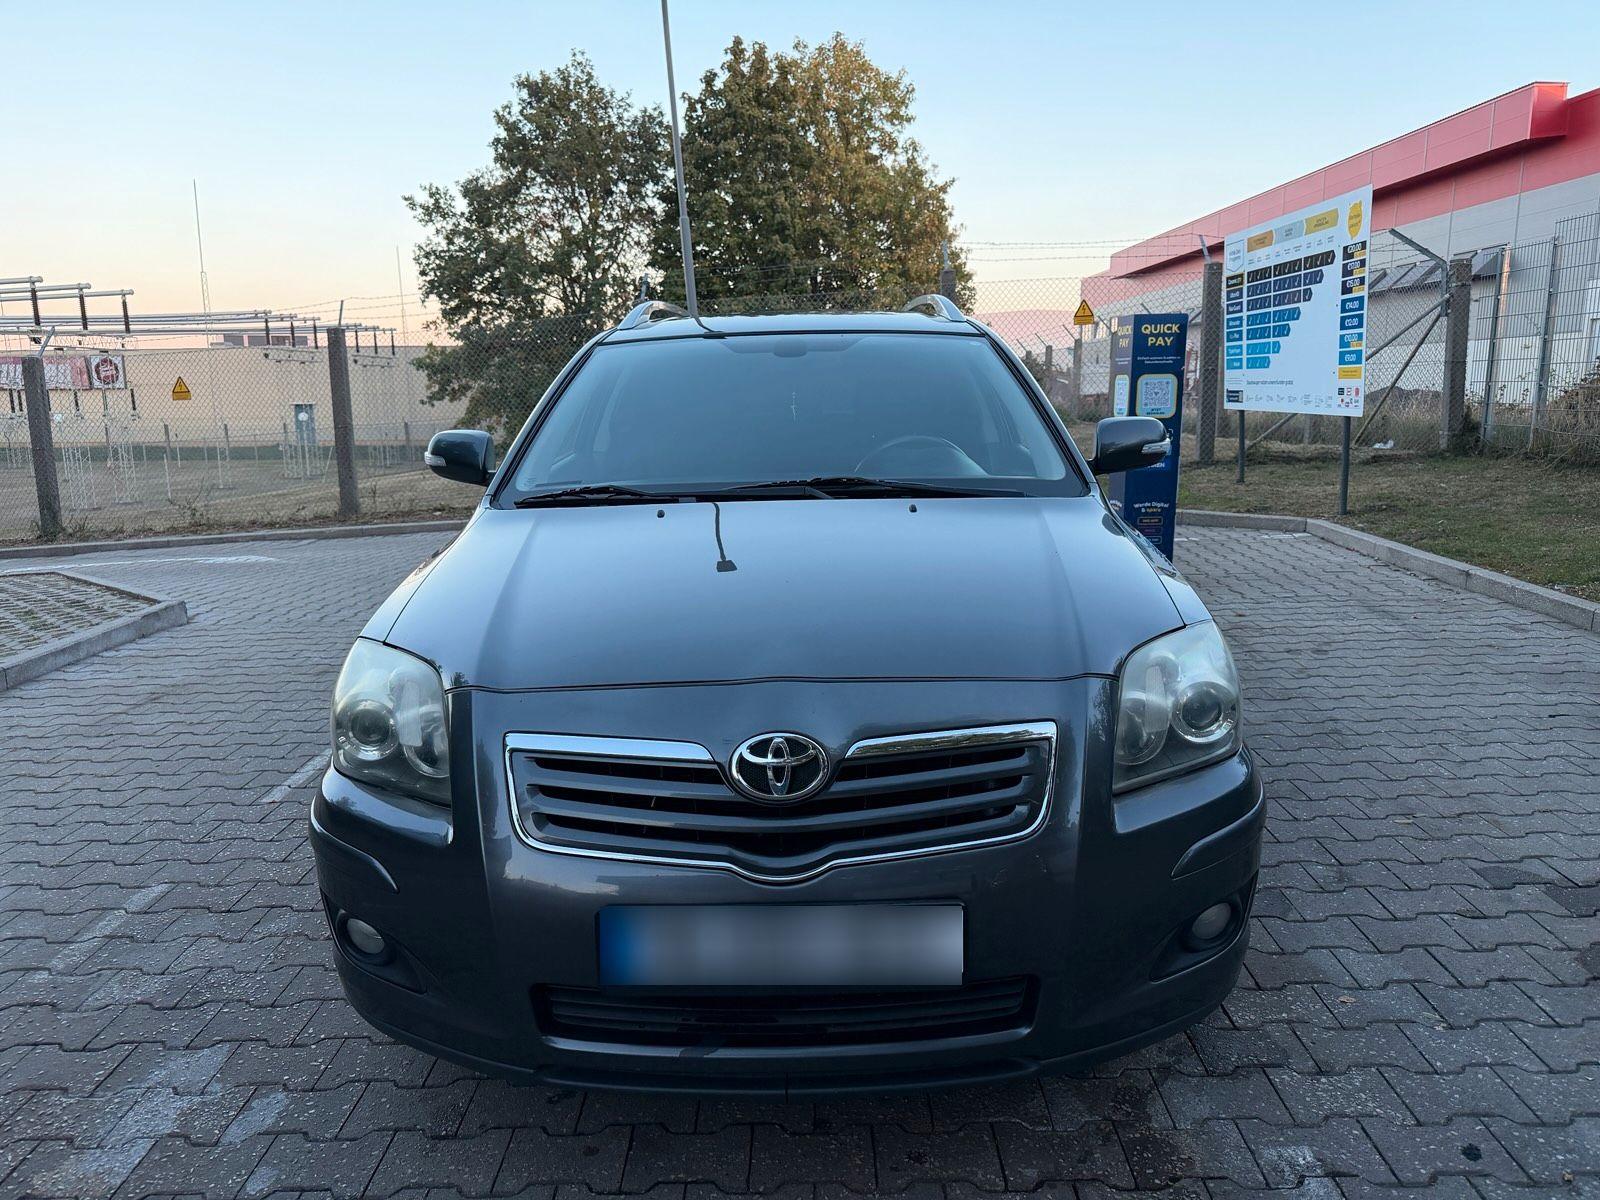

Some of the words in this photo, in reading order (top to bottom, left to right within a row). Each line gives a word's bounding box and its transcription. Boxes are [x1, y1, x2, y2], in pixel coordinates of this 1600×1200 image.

[1118, 326, 1132, 336] QUICK
[1142, 324, 1180, 334] QUICK
[1119, 338, 1129, 348] PAY
[1148, 336, 1174, 346] PAY
